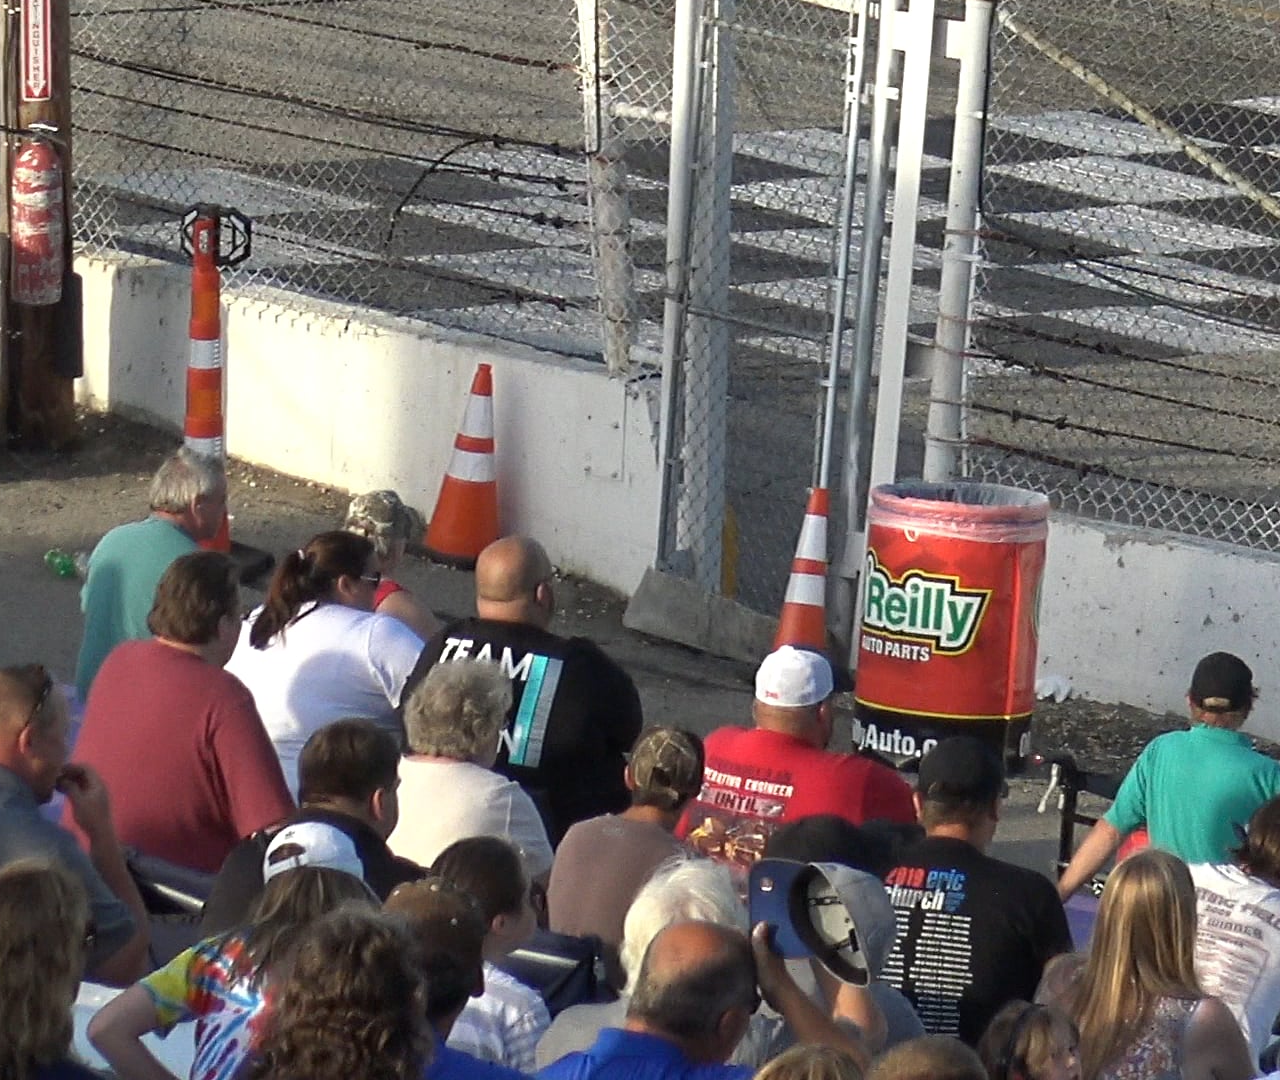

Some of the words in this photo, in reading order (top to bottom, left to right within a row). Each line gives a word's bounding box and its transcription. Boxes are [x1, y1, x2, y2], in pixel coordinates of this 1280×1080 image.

[440, 637, 534, 681] TEAM
[885, 640, 930, 662] PARTS
[744, 777, 794, 798] ENGINEER
[714, 790, 758, 813] UNTIL
[926, 868, 966, 891] eric
[1206, 918, 1263, 941] WINNER
